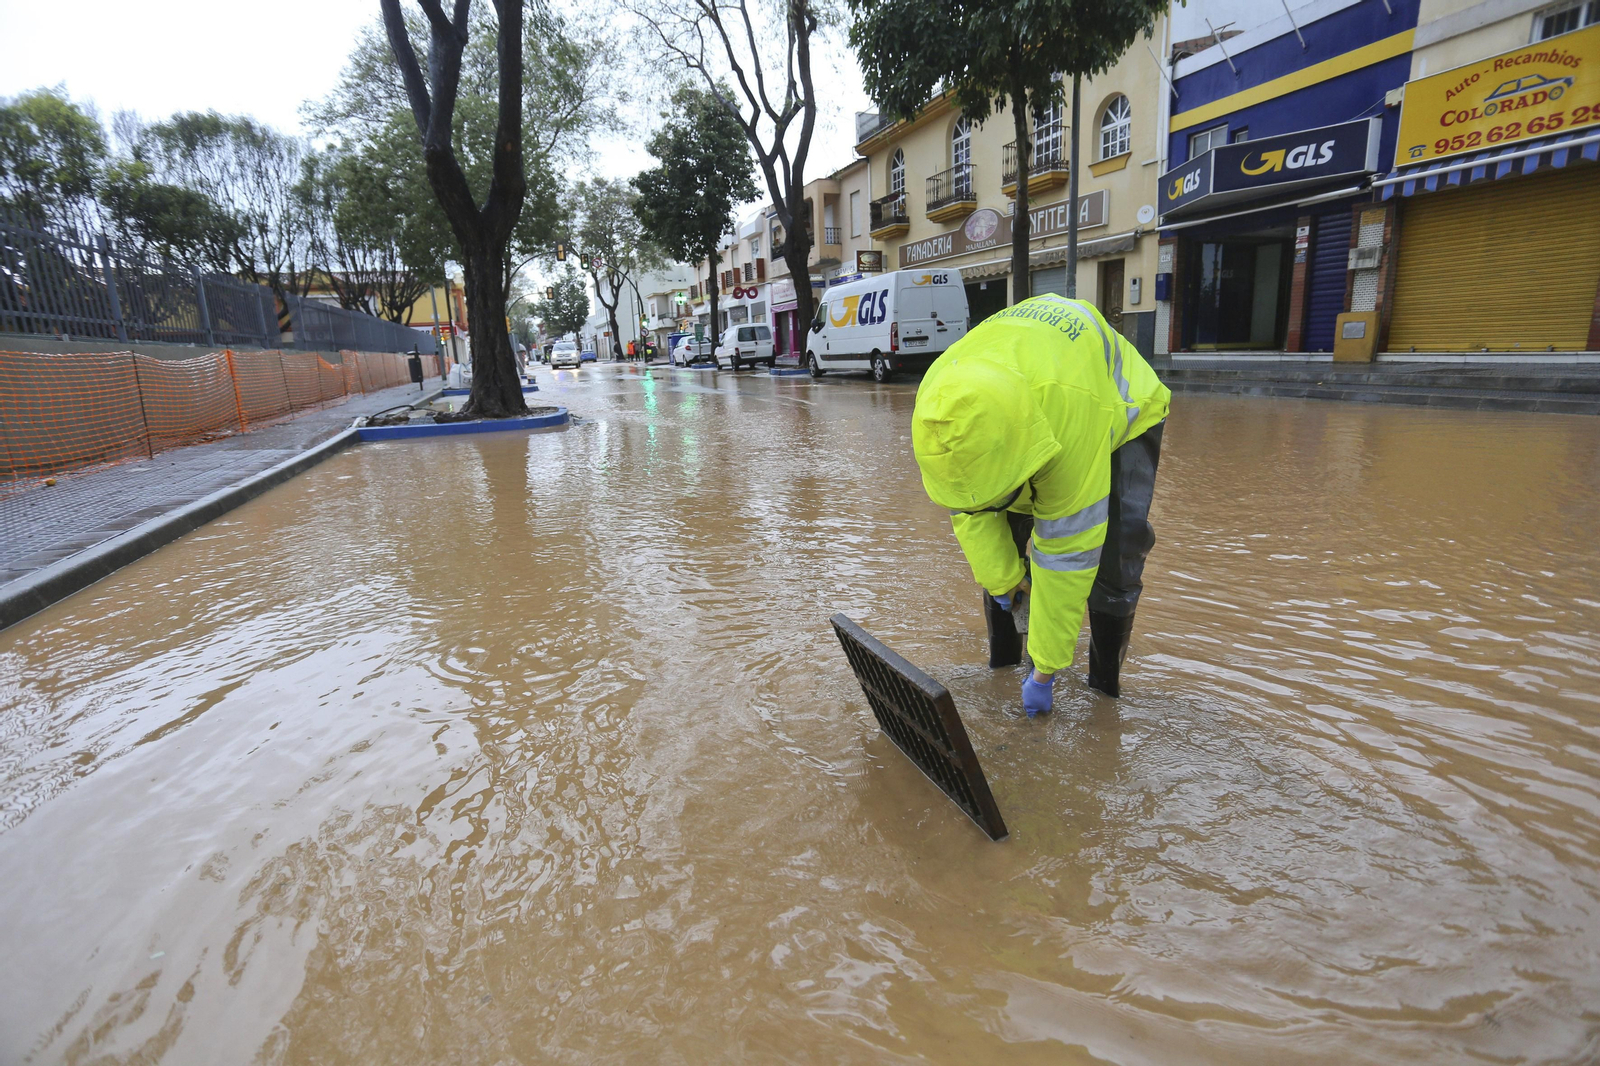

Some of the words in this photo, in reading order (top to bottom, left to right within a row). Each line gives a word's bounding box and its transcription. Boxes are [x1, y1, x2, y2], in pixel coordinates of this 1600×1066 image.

[1445, 71, 1480, 101] Auto
[1493, 49, 1582, 72] Recambios
[1434, 131, 1482, 154] 952
[1486, 122, 1522, 143] 62
[1526, 111, 1566, 134] 65
[1285, 140, 1336, 170] GLS
[1183, 168, 1201, 194] GLS
[906, 235, 952, 263] PANADERIA
[932, 274, 948, 285] GLS
[858, 289, 889, 326] GLS
[1053, 306, 1089, 332] AYTO
[1060, 321, 1081, 342] RC
